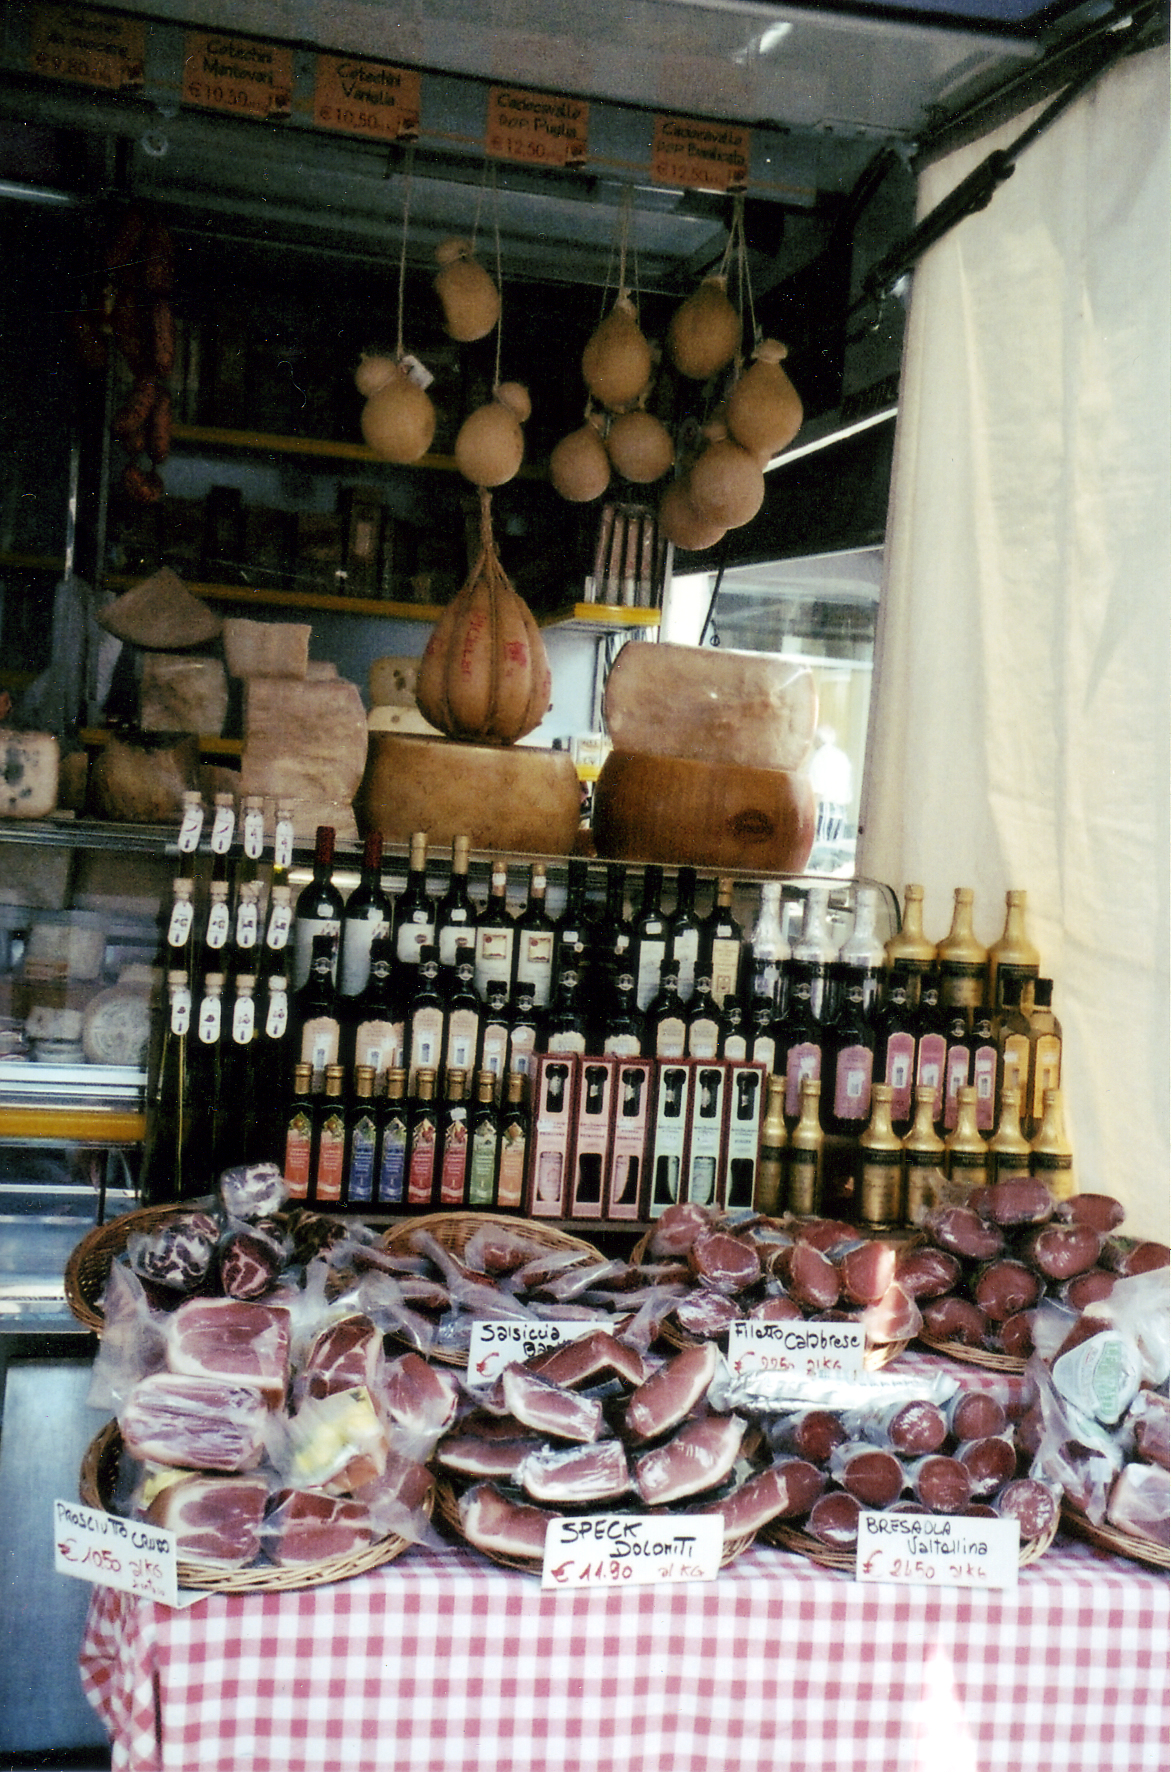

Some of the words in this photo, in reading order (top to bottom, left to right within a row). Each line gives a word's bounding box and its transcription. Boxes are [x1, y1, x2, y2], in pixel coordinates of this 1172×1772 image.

[480, 1323, 560, 1342] Salsiccia
[784, 1329, 861, 1350] Calabrese
[476, 1352, 500, 1378] €
[560, 1519, 643, 1544] SPECK
[866, 1516, 951, 1536] BRESAOLA
[57, 1538, 78, 1562] €
[907, 1535, 989, 1556] Valtellina
[550, 1560, 575, 1583] €
[578, 1560, 633, 1582] 11.90
[862, 1549, 883, 1578] €
